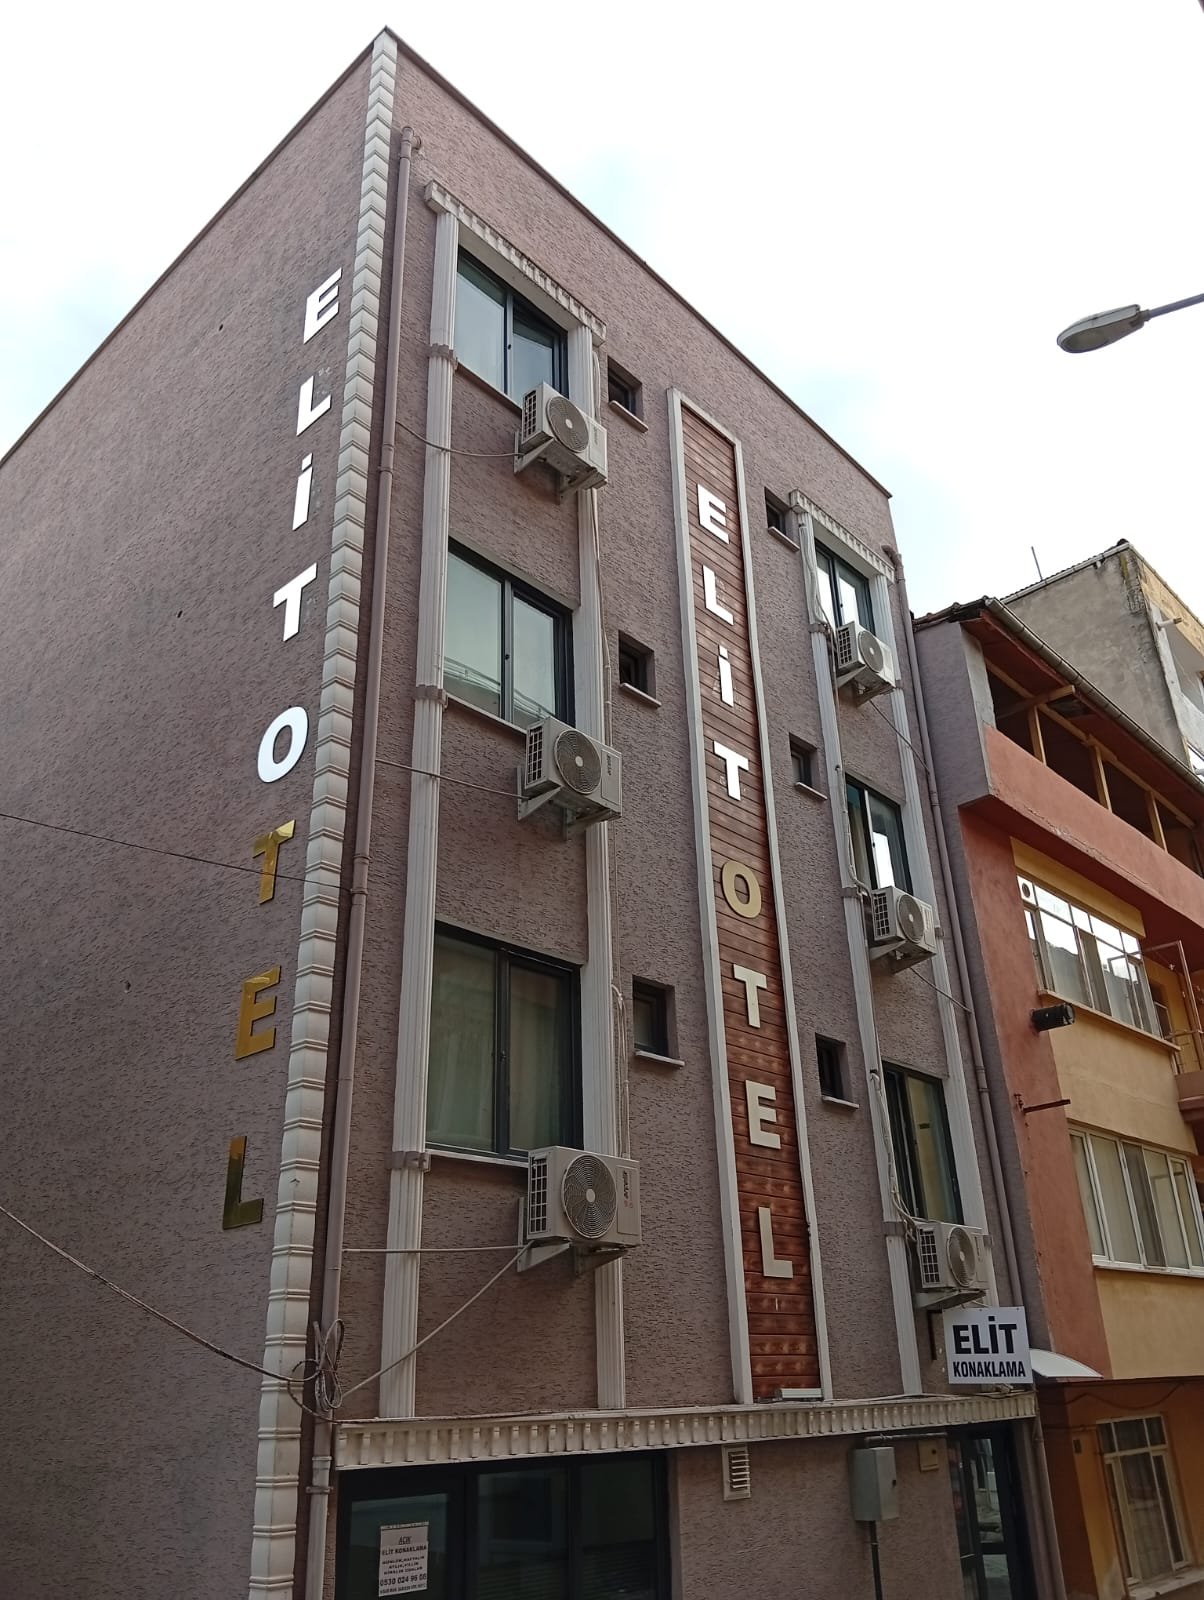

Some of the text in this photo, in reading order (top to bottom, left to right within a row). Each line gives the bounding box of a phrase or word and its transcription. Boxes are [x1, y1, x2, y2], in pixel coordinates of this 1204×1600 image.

[222, 706, 309, 1230] OTEL
[721, 859, 793, 1279] OTEL
[953, 1361, 1026, 1378] KONAKLAMA
